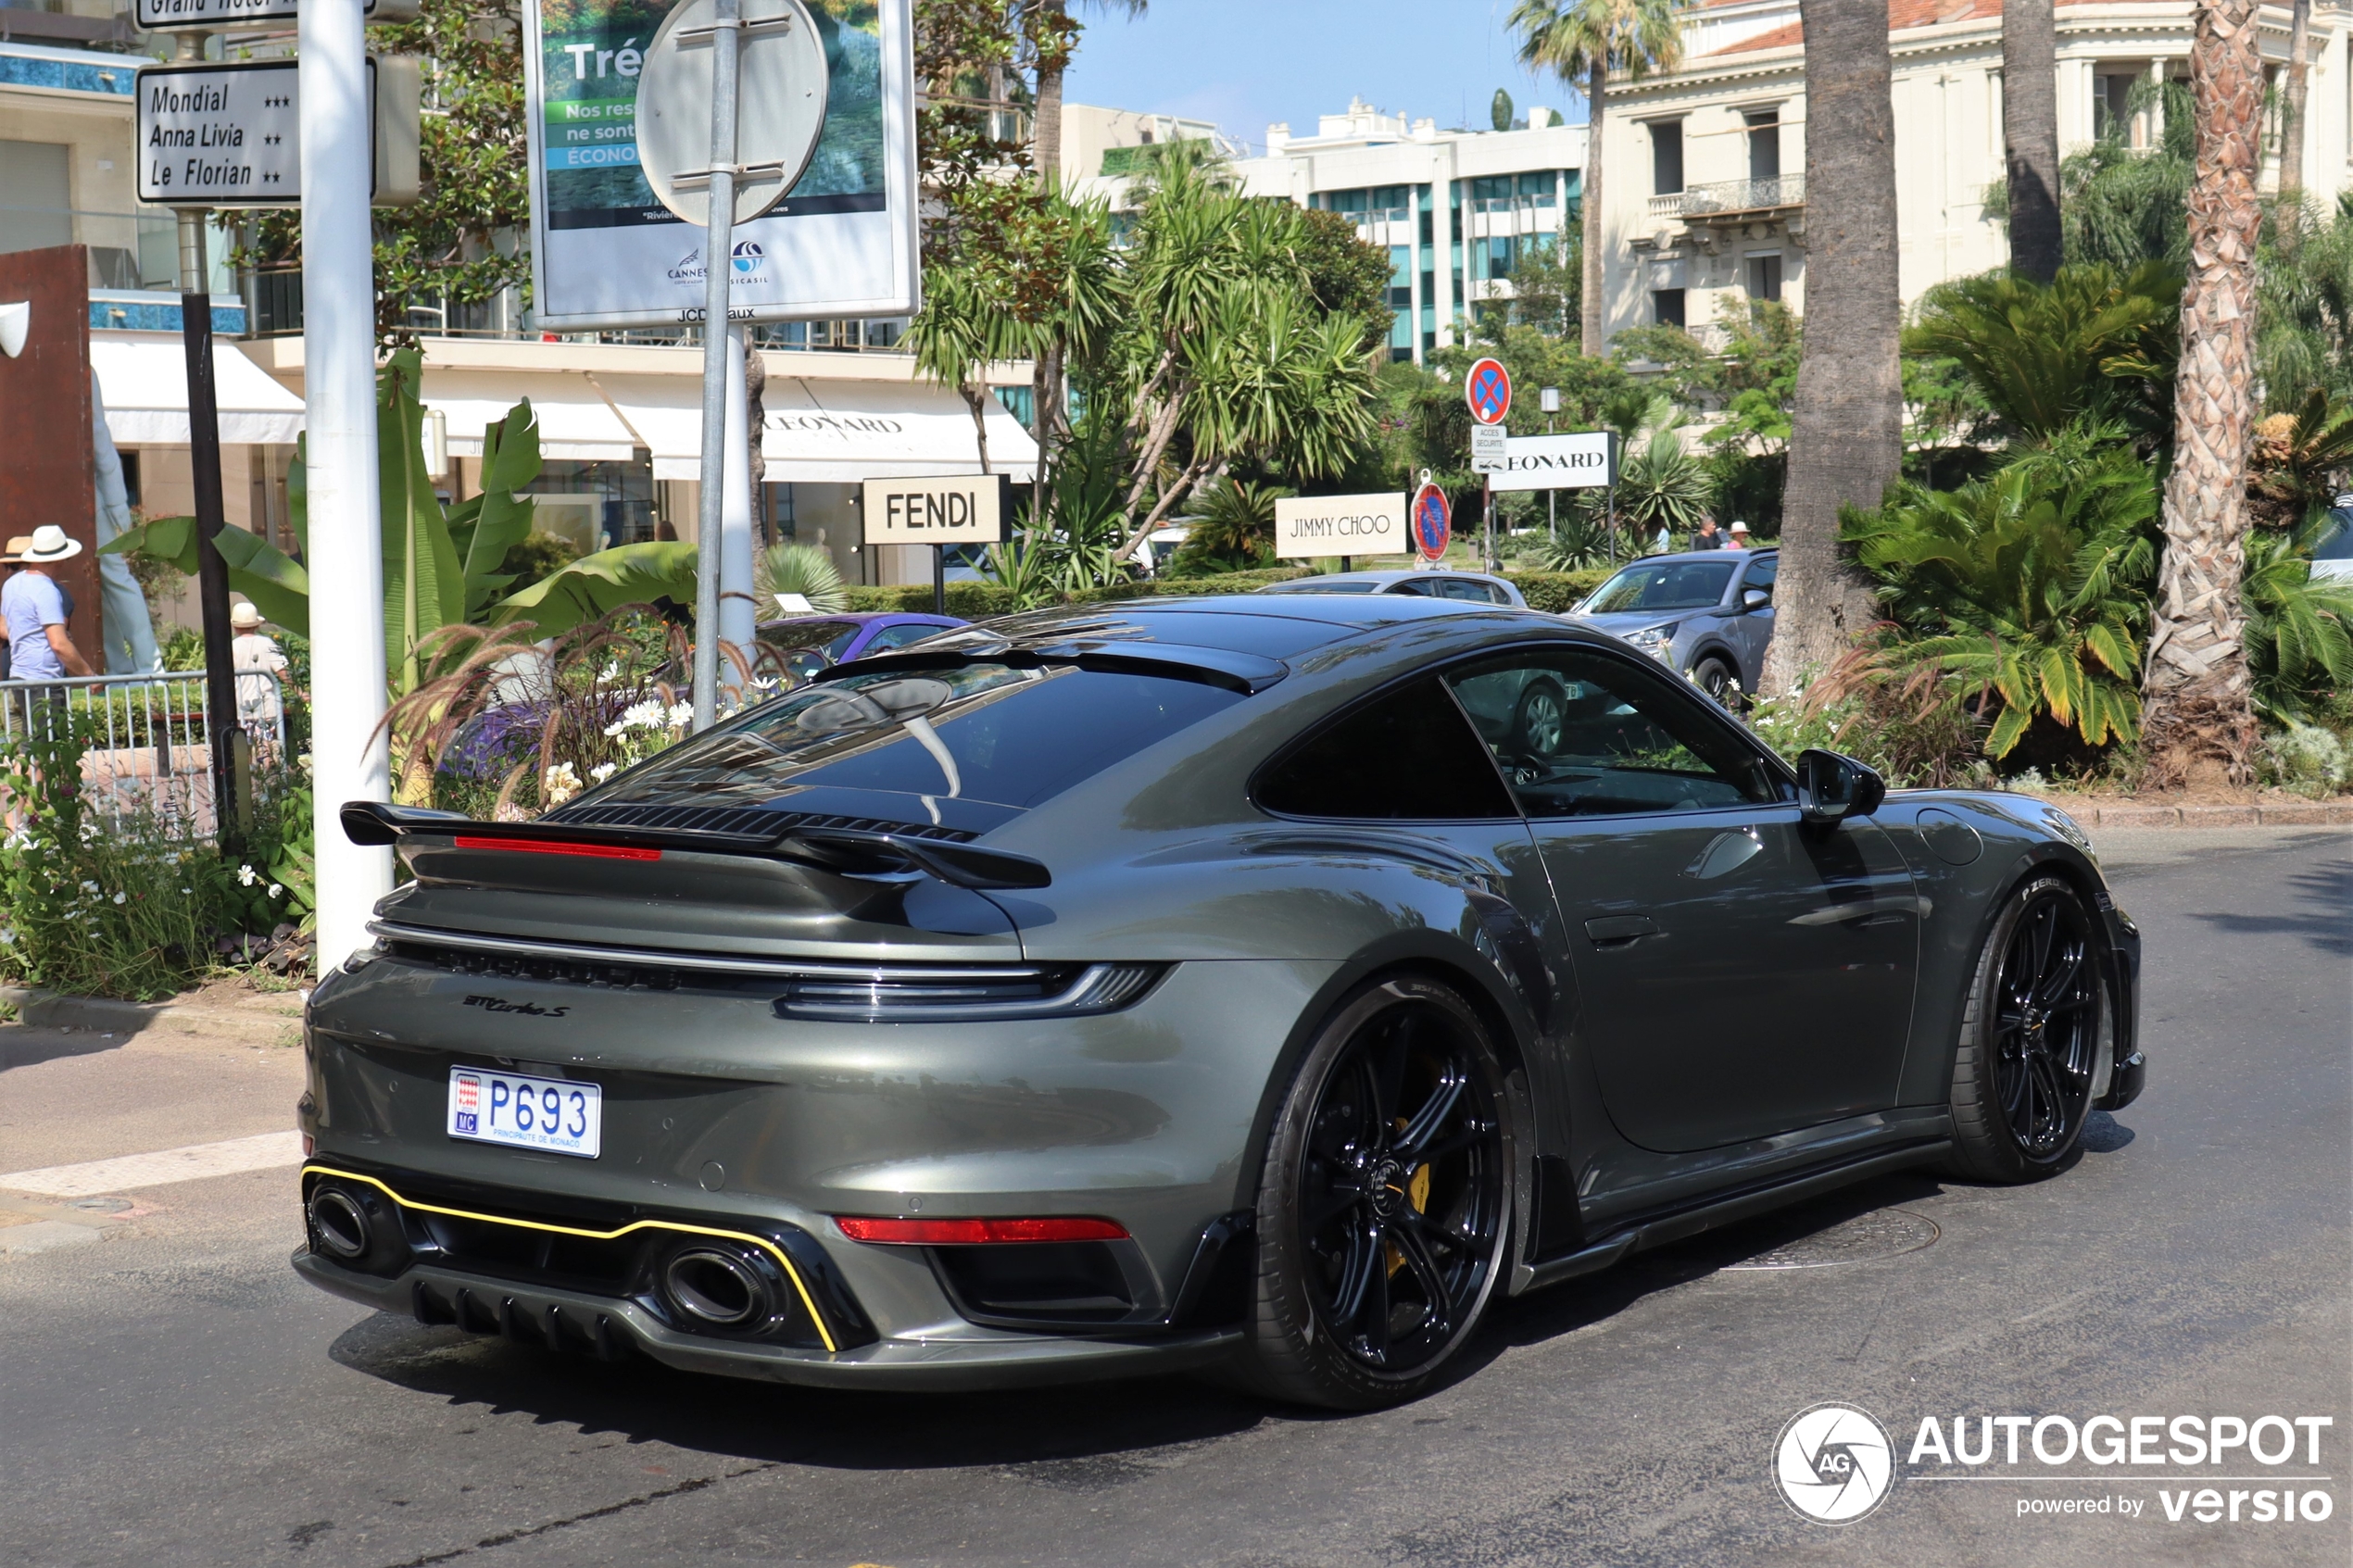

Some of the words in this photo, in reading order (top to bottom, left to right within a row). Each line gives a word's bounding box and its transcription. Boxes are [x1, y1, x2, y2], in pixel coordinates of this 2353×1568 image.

[564, 38, 650, 80] Tré
[151, 83, 228, 113] Mondial
[566, 104, 601, 119] Nos
[606, 103, 635, 116] res
[149, 124, 195, 147] Anna
[200, 123, 244, 147] Livia
[567, 128, 589, 141] ne
[595, 123, 635, 139] sont
[568, 147, 639, 165] ÉCONO
[151, 159, 171, 186] Le
[184, 157, 251, 185] Florian
[730, 277, 768, 285] SICASIL
[677, 308, 755, 322] JCDaux
[1507, 452, 1604, 470] EONARD
[887, 492, 975, 529] FENDI
[1290, 518, 1334, 537] JIMMY
[1338, 514, 1390, 535] CHOO
[2030, 877, 2059, 893] ZERO
[490, 1079, 586, 1138] P693
[459, 1115, 474, 1131] MC
[493, 1128, 536, 1142] PRINCIPAUTE
[538, 1135, 548, 1144] DE
[550, 1136, 580, 1148] MONACO
